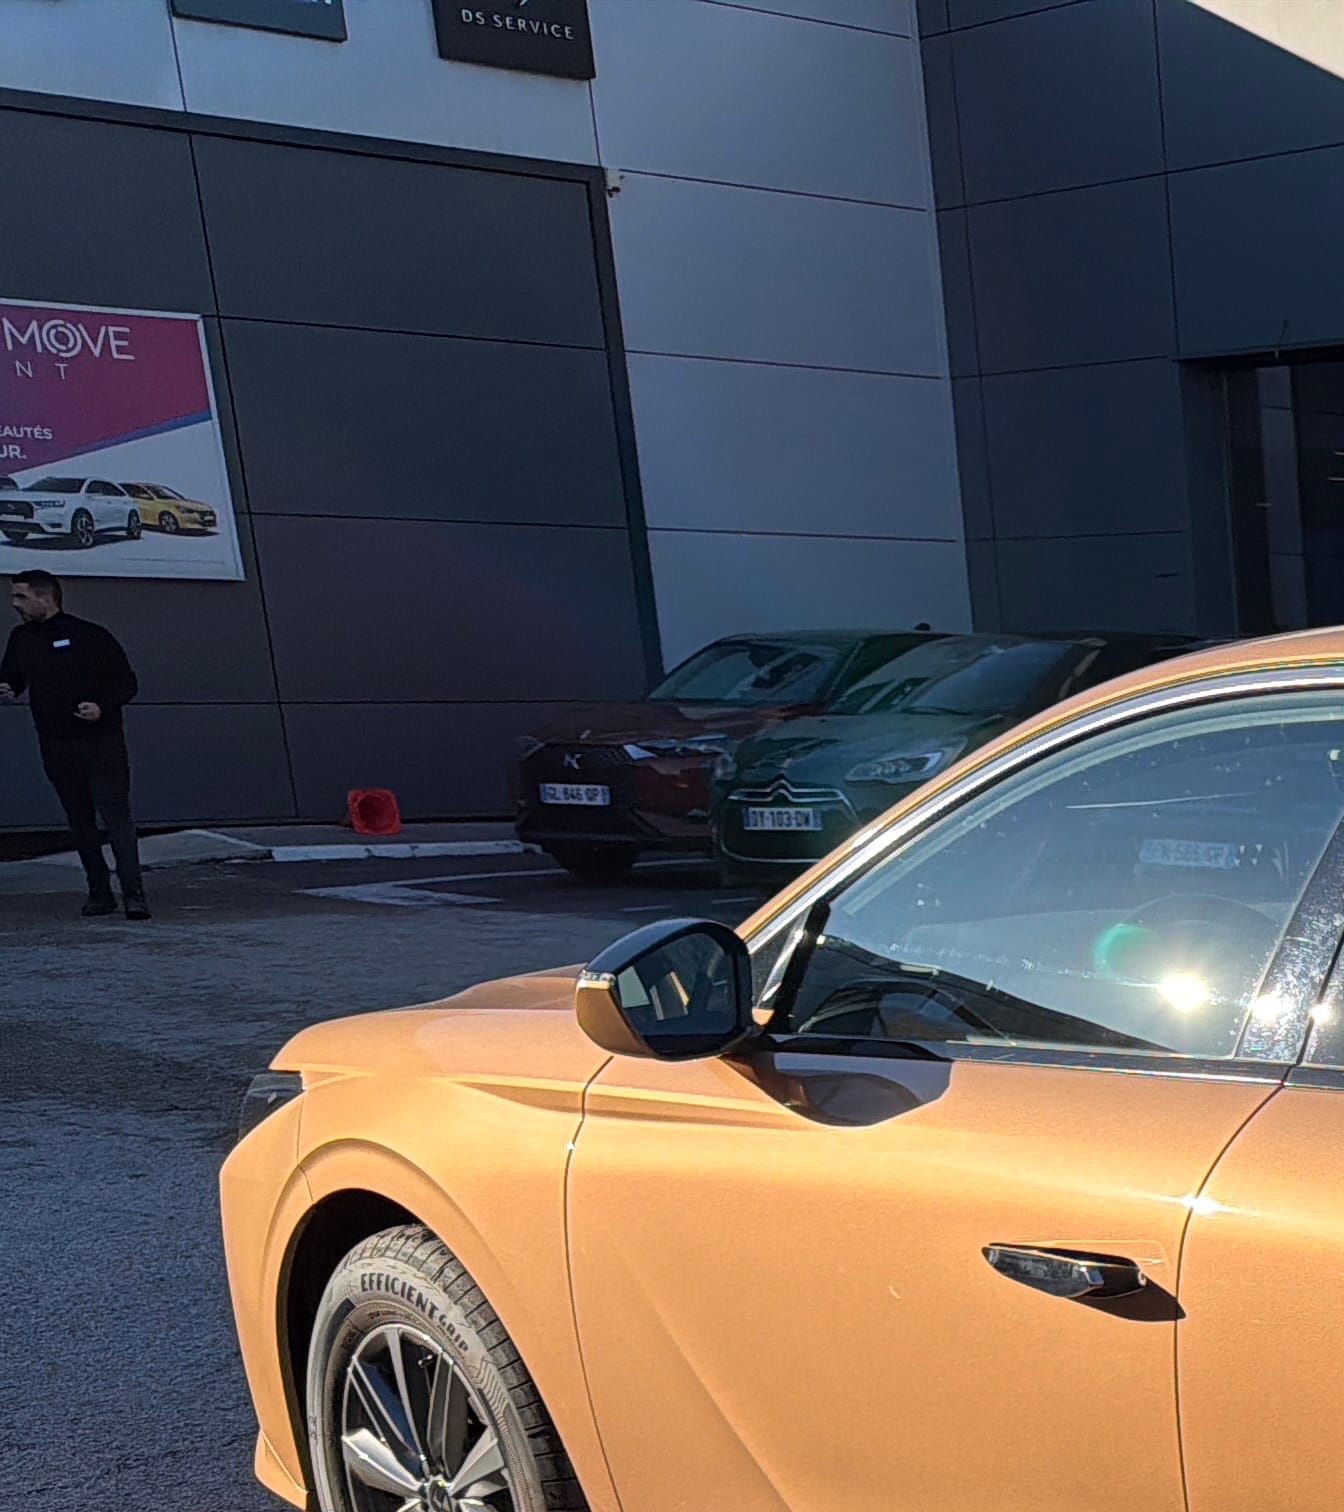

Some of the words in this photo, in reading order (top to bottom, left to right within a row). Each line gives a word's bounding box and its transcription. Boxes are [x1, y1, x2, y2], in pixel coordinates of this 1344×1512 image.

[461, 9, 485, 25] DS
[493, 14, 575, 40] SERVICE
[2, 317, 136, 360] MOVE
